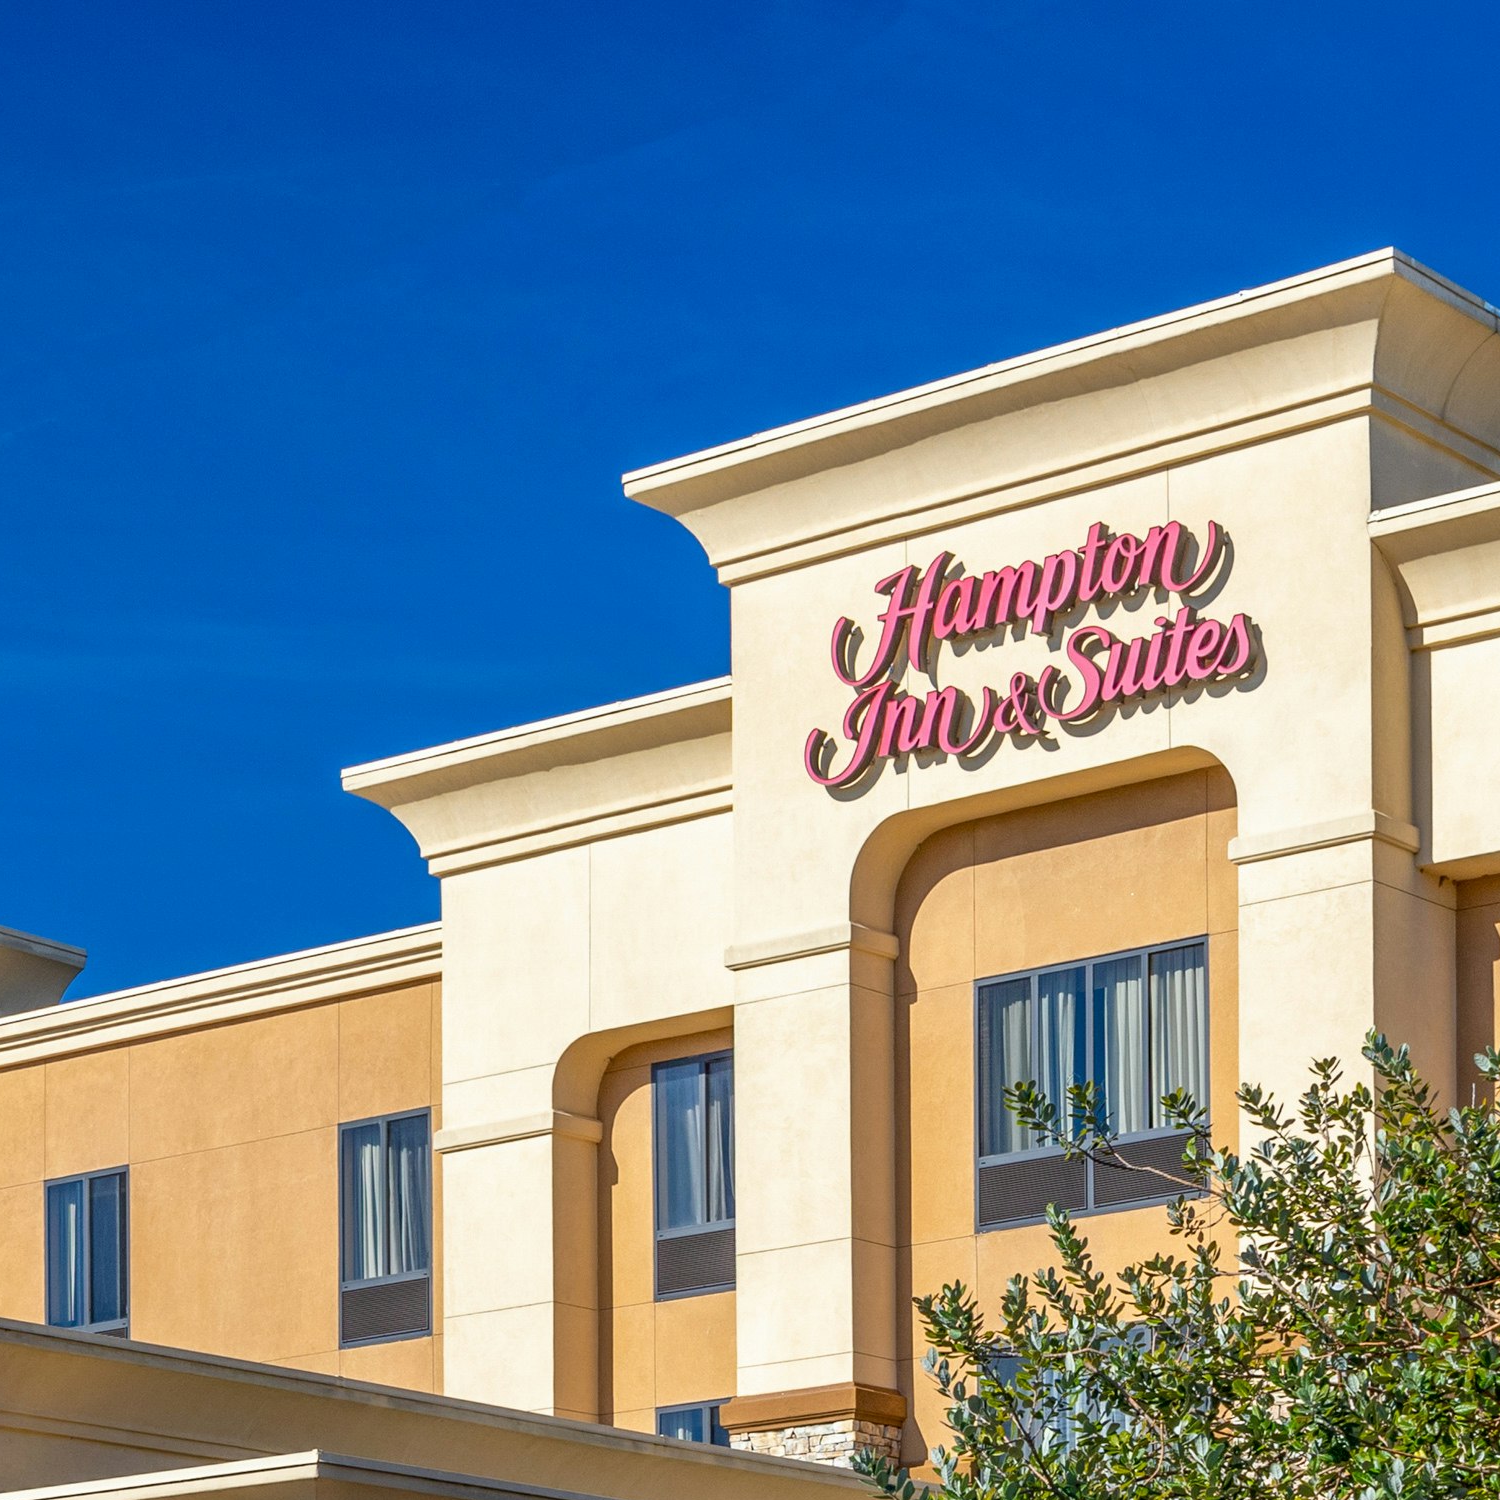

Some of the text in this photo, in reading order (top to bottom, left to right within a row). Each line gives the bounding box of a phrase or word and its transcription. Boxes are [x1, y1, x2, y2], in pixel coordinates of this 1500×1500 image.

[832, 520, 1224, 687] Hampton
[804, 605, 1257, 788] Inn & Suites
